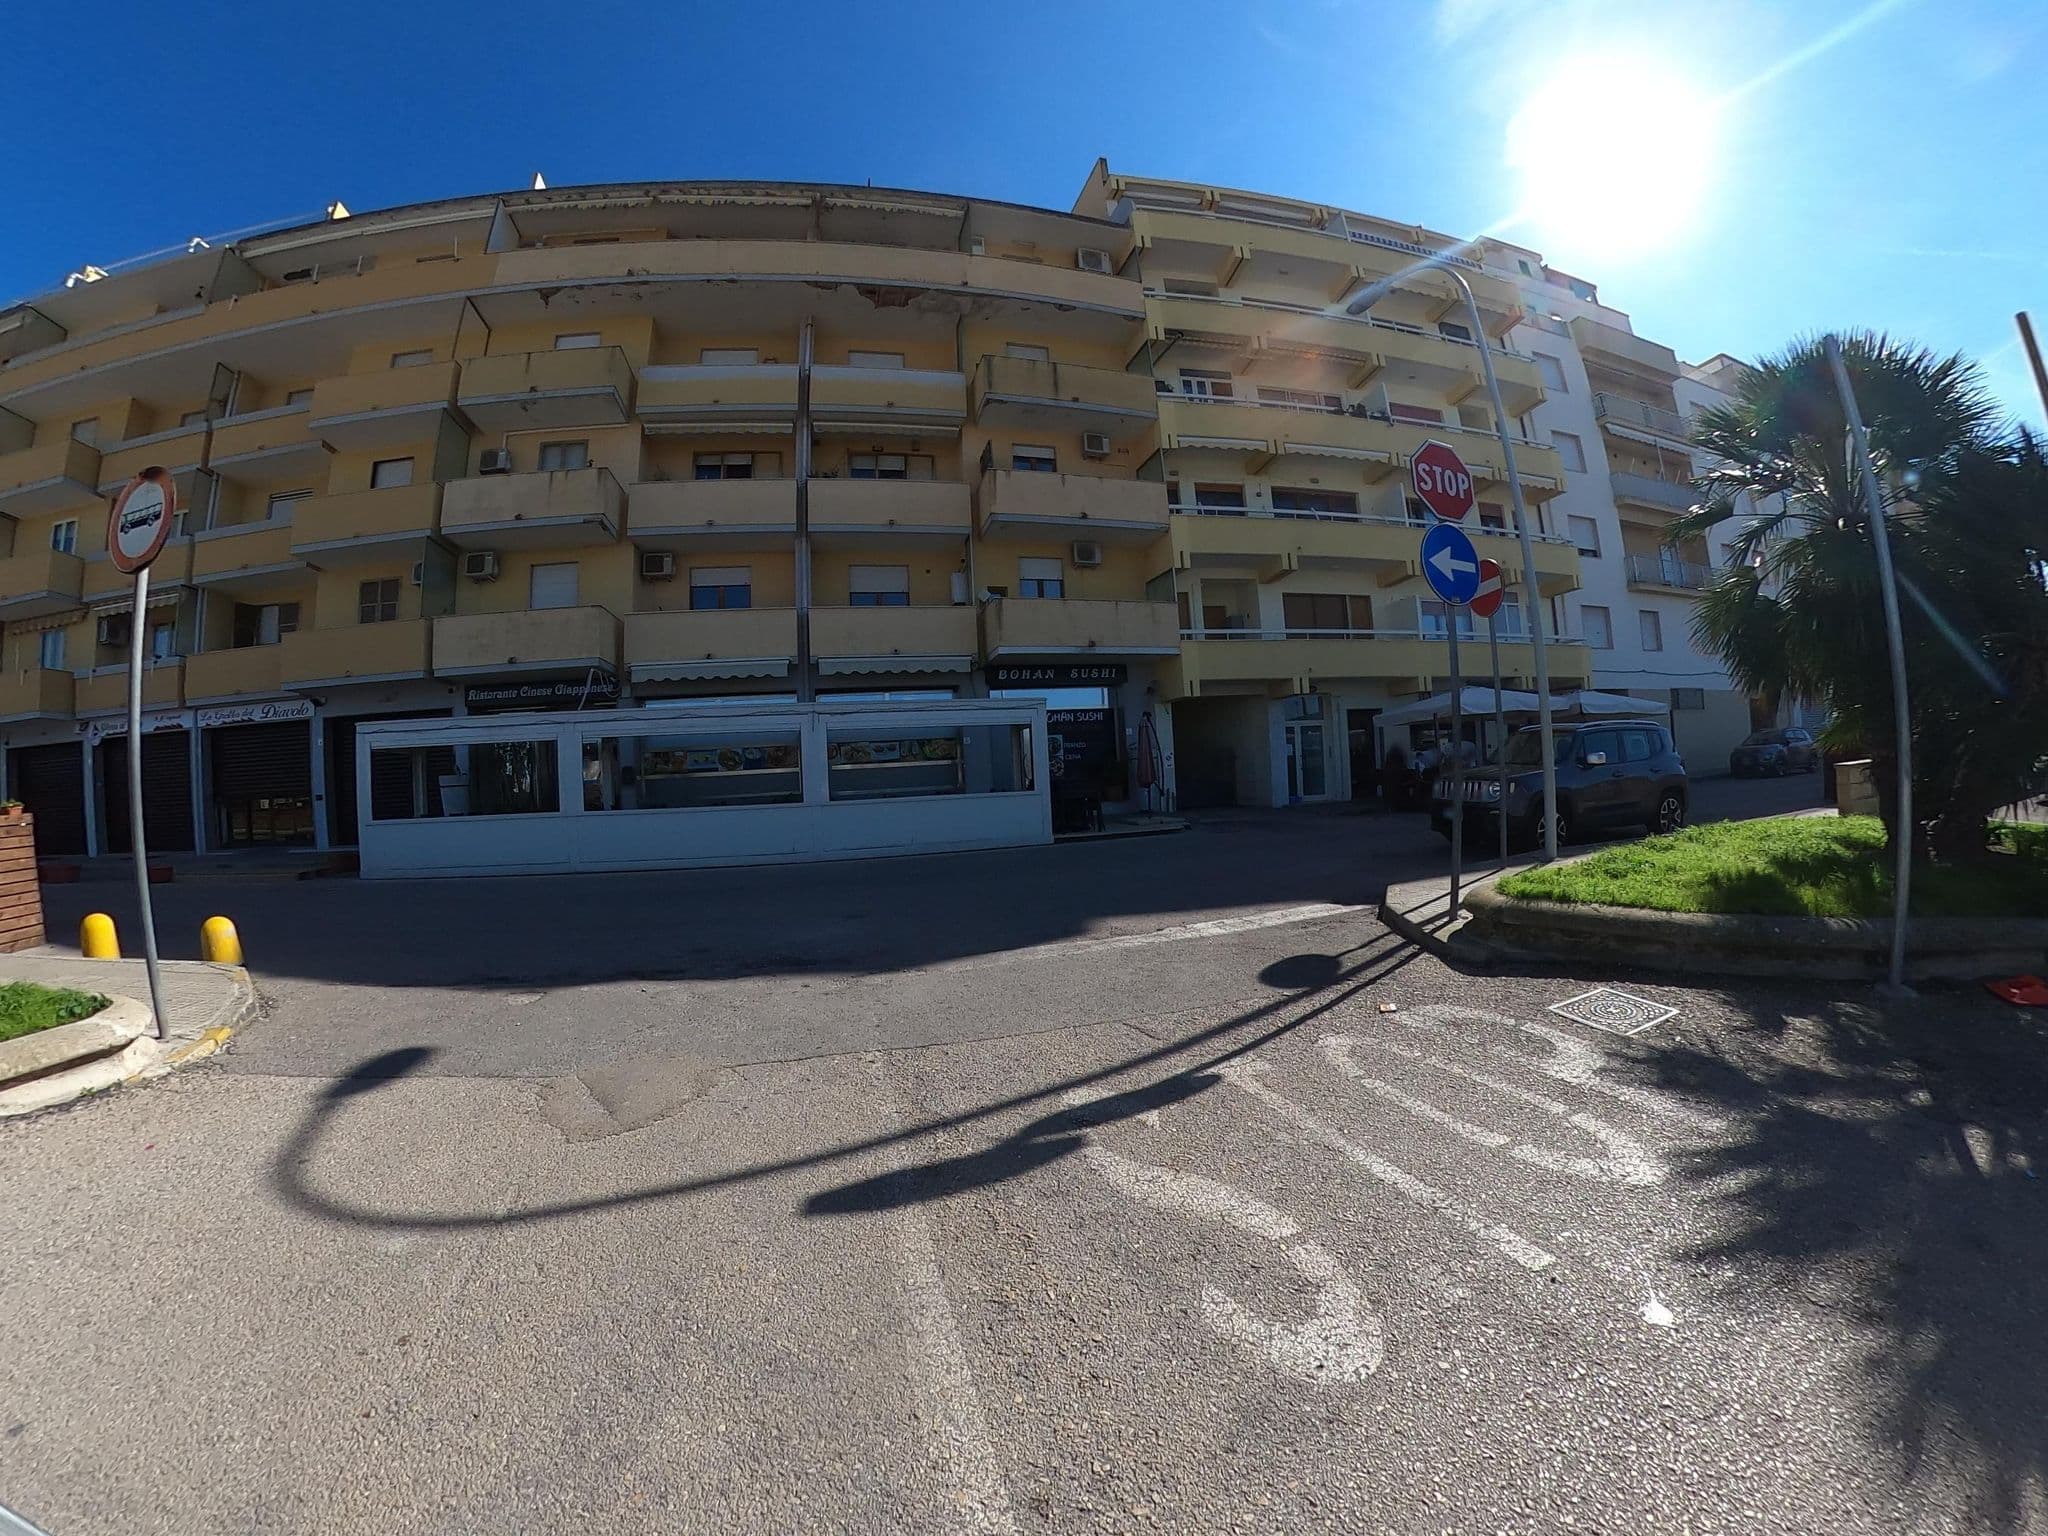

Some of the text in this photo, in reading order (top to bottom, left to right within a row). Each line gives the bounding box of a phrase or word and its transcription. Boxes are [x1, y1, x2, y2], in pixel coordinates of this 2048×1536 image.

[1417, 462, 1469, 499] STOP
[998, 667, 1117, 680] BOHAN SUSHI
[468, 688, 518, 701] Ristorante
[520, 684, 553, 698] Cinese
[260, 702, 310, 718] Diavolo
[1046, 711, 1104, 724] OHAN SUSHI
